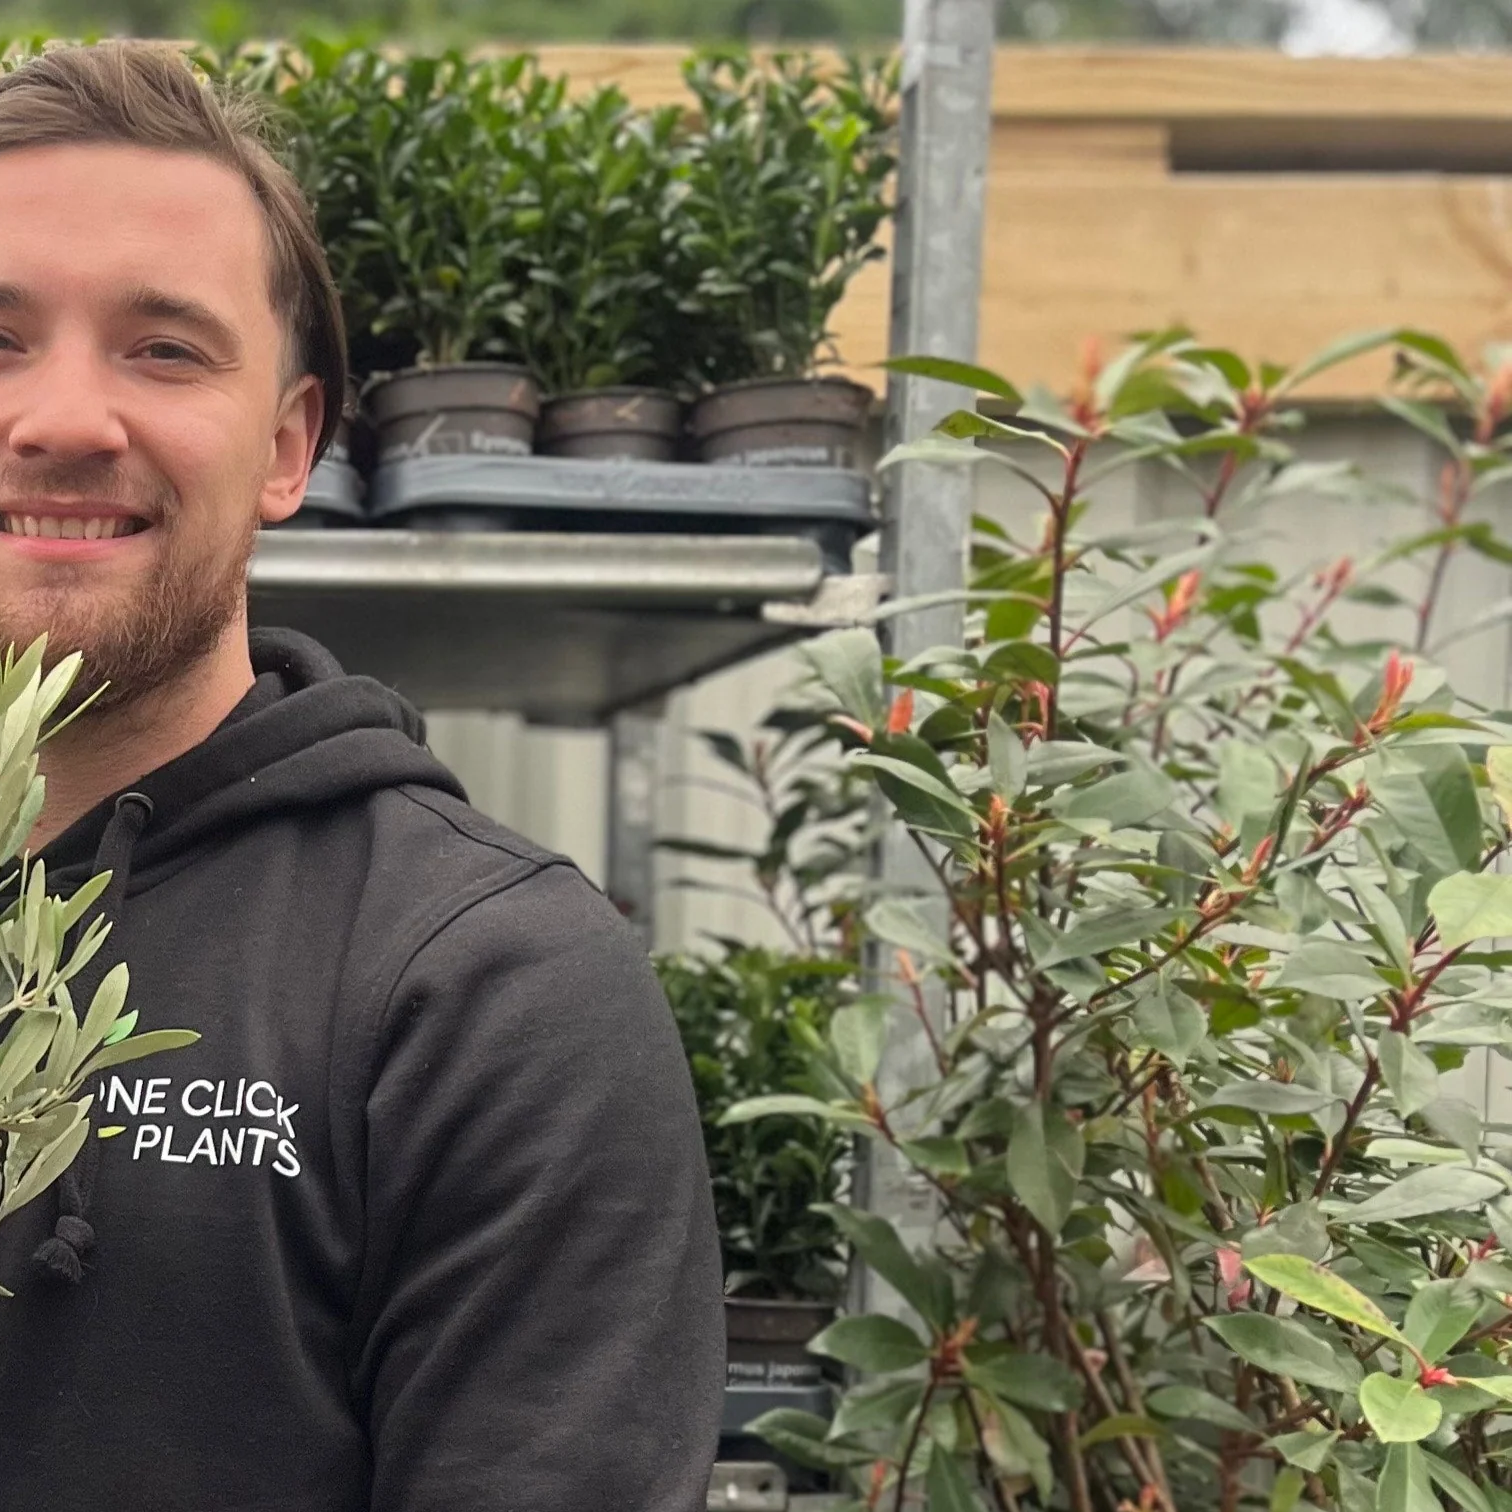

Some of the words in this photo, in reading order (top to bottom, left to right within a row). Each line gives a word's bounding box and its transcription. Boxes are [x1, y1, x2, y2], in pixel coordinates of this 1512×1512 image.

[99, 1075, 172, 1116] NE
[181, 1077, 299, 1139] CLICK
[132, 1123, 301, 1177] PLANTS
